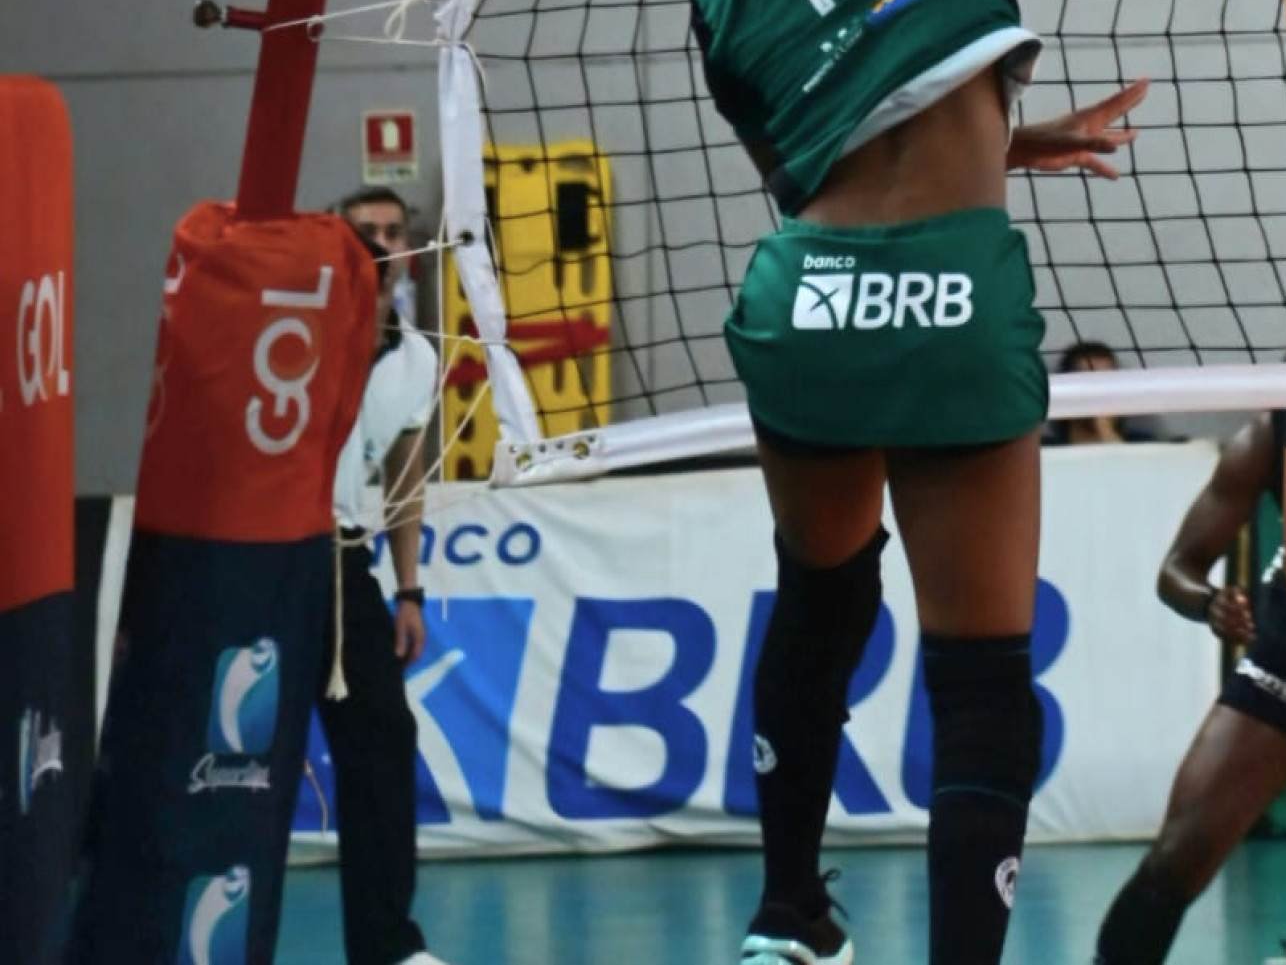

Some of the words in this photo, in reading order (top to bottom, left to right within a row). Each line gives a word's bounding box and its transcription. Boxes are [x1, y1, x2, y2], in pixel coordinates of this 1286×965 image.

[803, 253, 856, 269] banco
[853, 271, 974, 330] BRB
[17, 271, 69, 406] GOL
[245, 266, 333, 455] GOL
